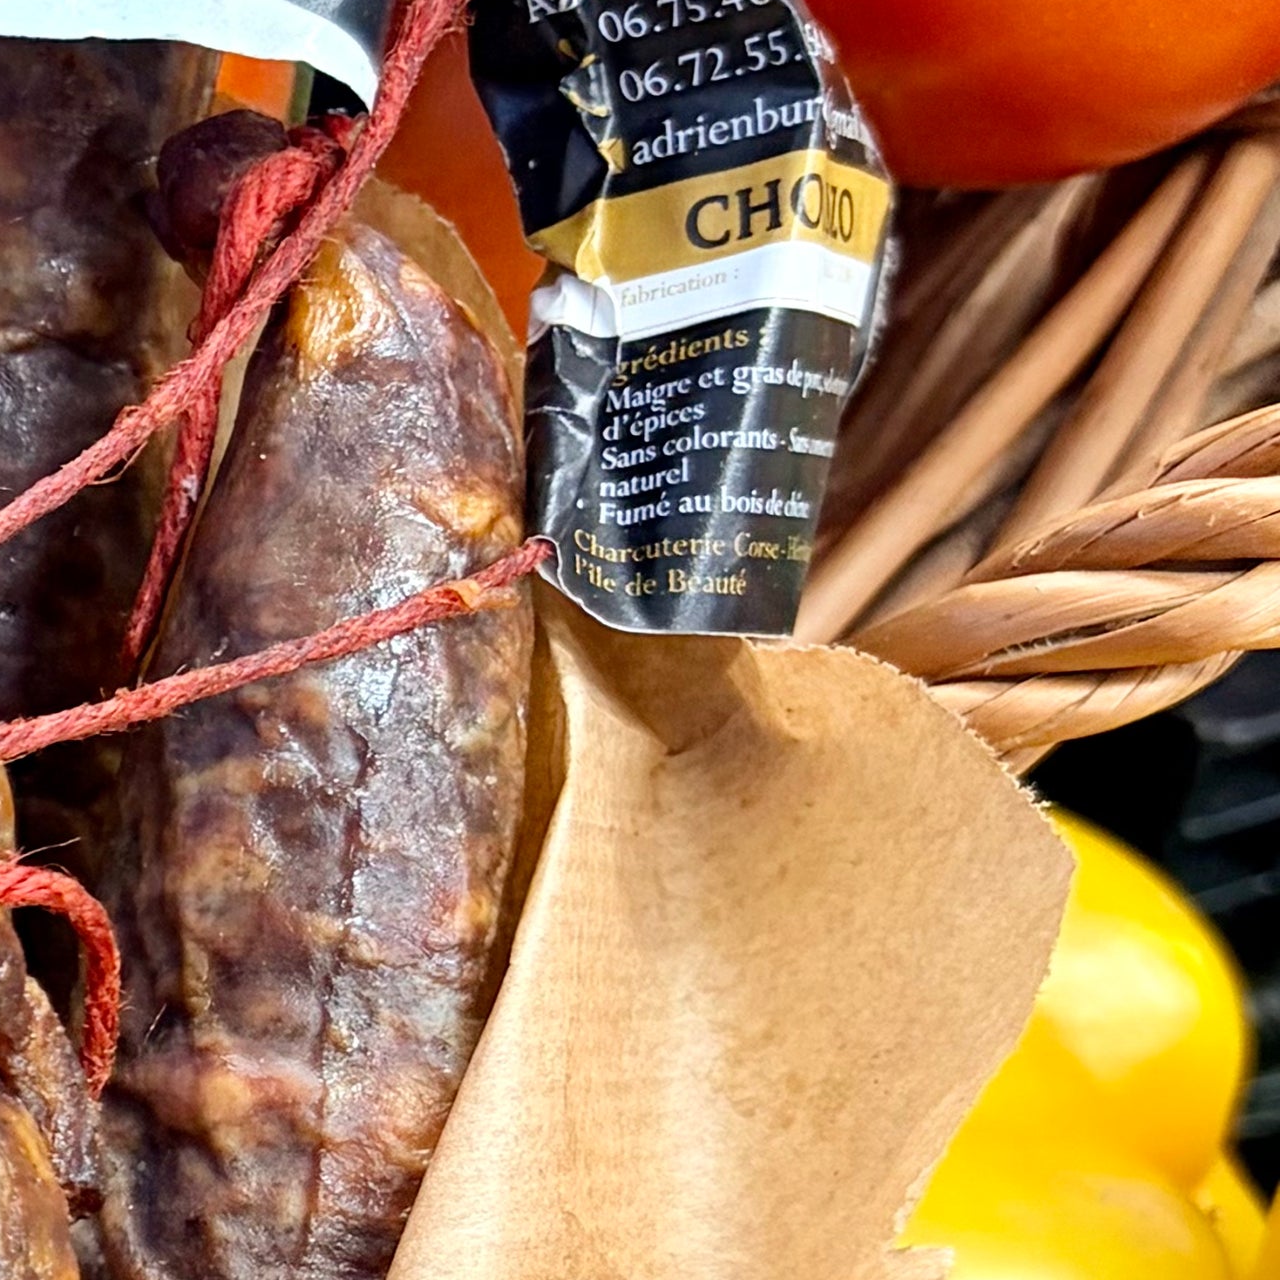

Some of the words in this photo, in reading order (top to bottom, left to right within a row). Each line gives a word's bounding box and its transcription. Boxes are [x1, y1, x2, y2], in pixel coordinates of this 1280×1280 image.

[605, 376, 691, 413] Maigre
[698, 368, 726, 390] et
[732, 364, 784, 396] gras
[602, 401, 707, 443] d'épices
[601, 443, 657, 472] Sans
[663, 424, 778, 457] colorants
[599, 458, 690, 499] naturel
[599, 493, 671, 528] Fumé
[678, 493, 712, 516] au
[721, 486, 764, 516] bois
[573, 528, 726, 565] Charcuterie
[624, 572, 658, 597] de
[667, 568, 748, 597] Beauté
